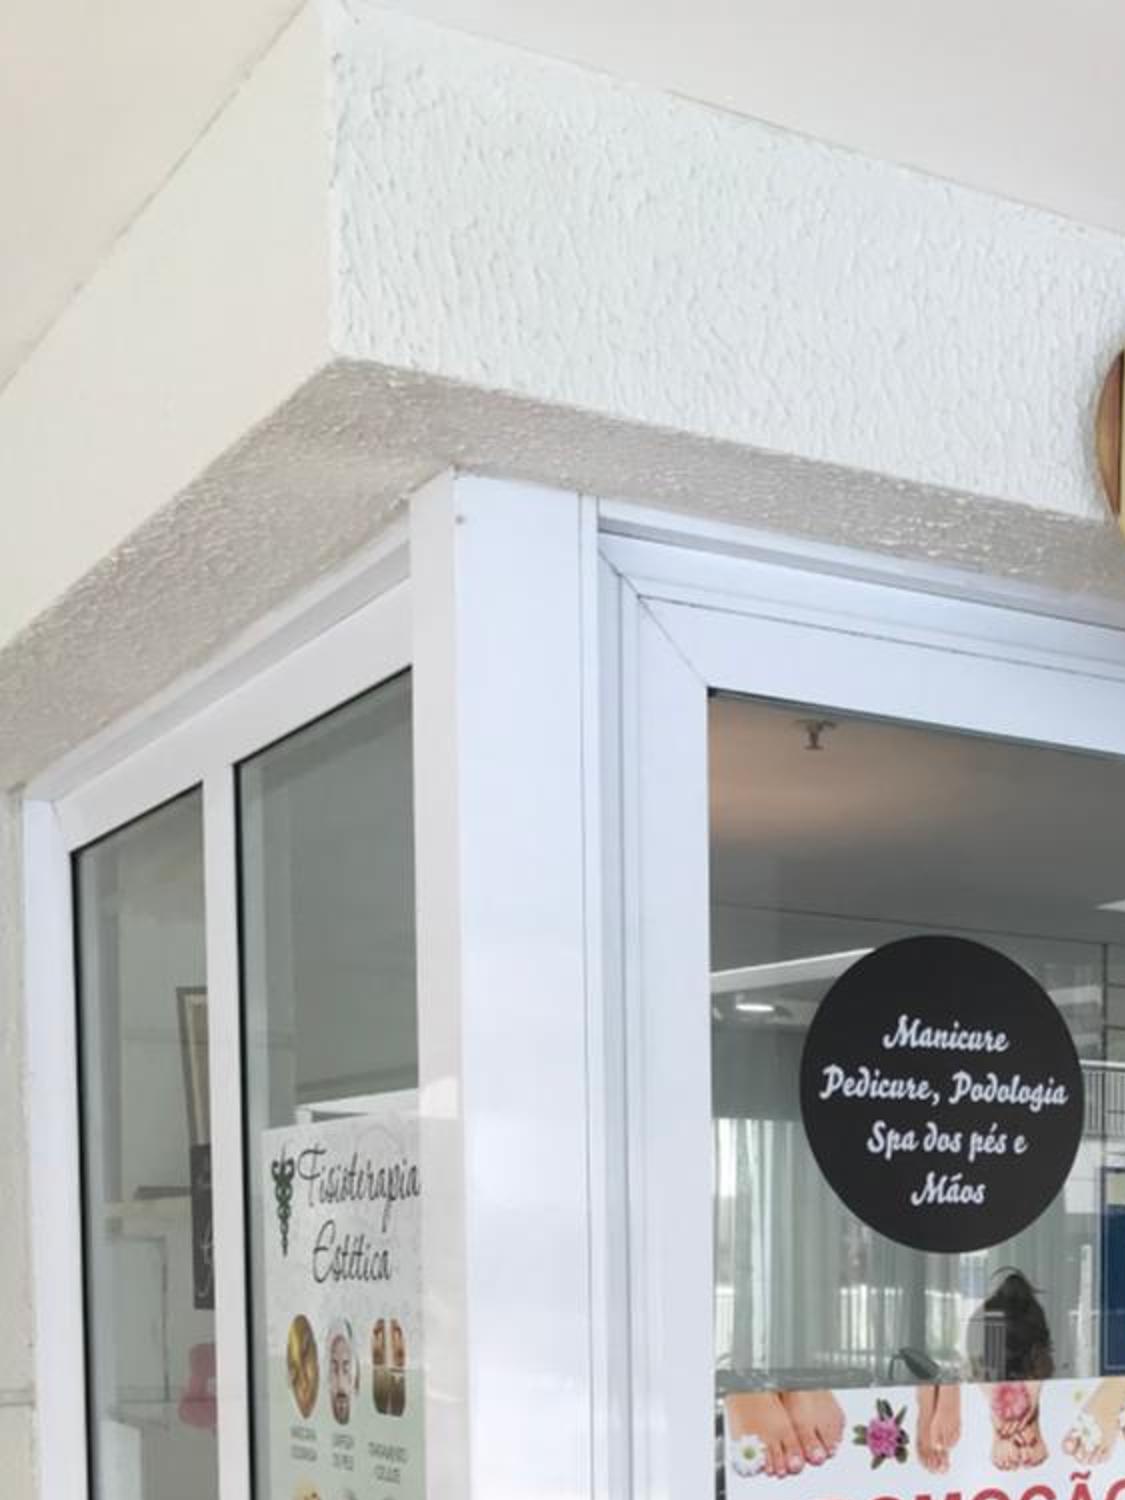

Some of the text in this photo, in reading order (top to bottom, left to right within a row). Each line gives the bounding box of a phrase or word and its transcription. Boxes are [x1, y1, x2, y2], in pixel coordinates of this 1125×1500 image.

[883, 1015, 1008, 1051] Manicure
[819, 1065, 1068, 1111] Pedicure, Podologia
[867, 1120, 1028, 1160] Spa dos pés e
